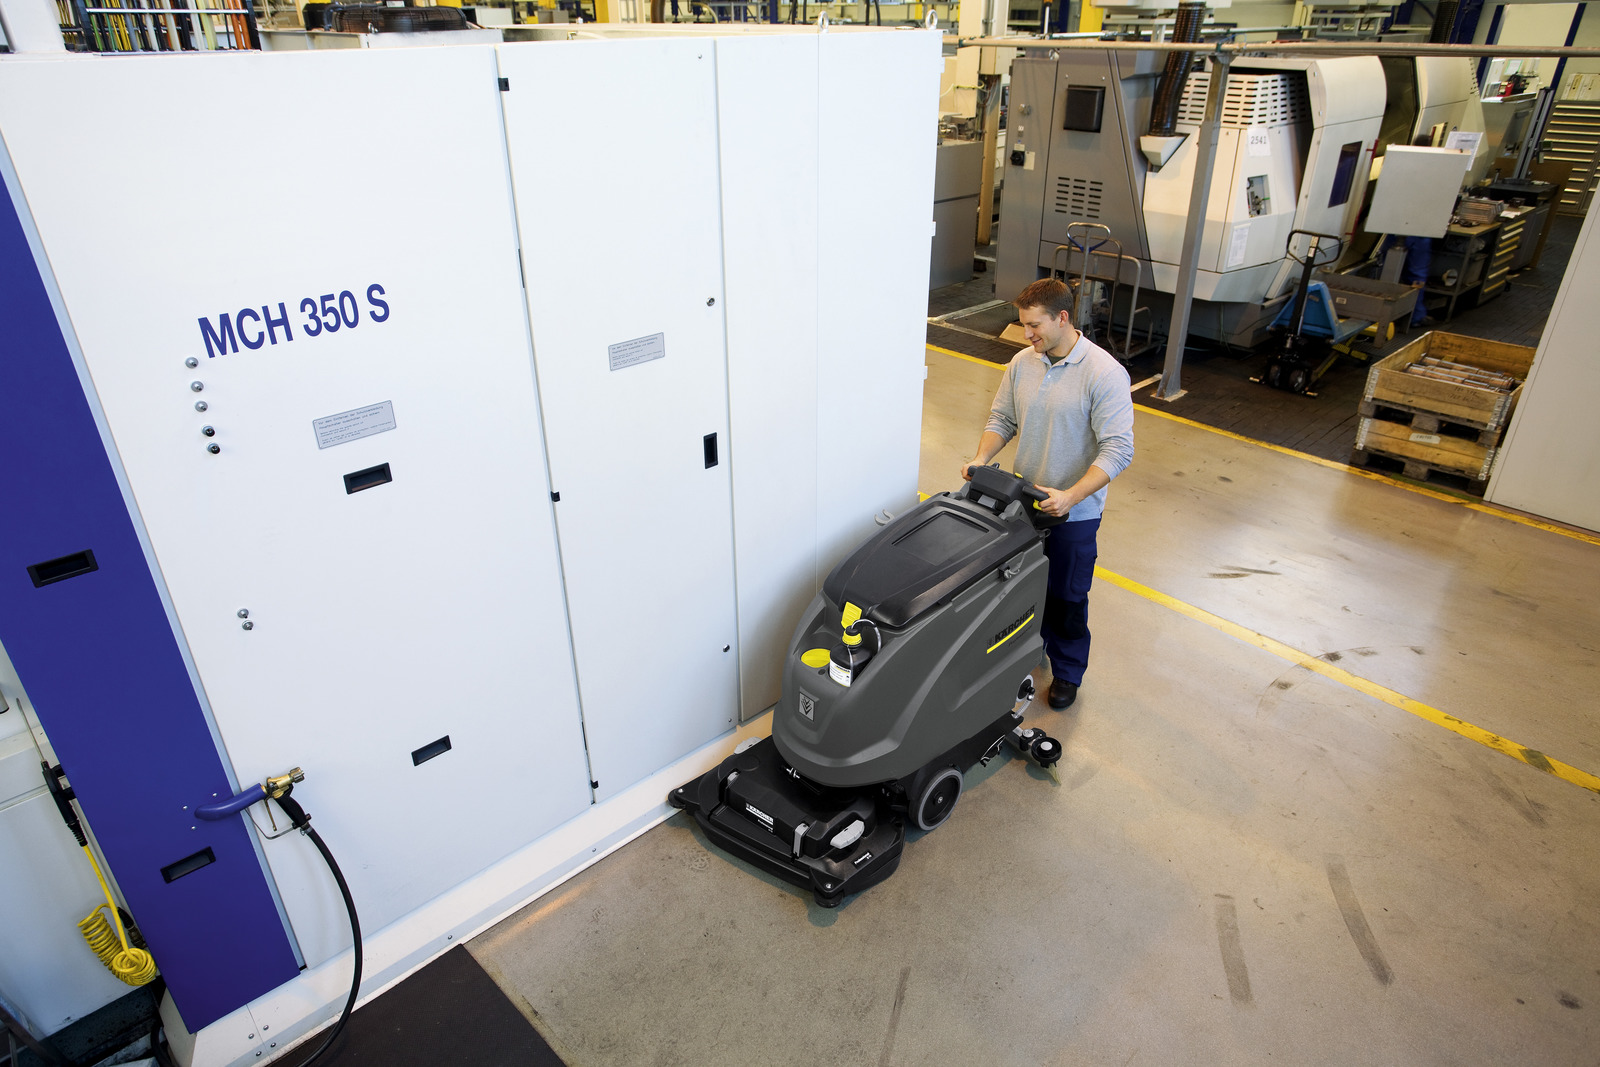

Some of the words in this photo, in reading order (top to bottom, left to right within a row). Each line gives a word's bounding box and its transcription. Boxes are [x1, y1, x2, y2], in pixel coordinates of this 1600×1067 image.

[1250, 135, 1267, 145] 2541
[198, 302, 293, 358] MCH
[300, 290, 359, 337] 350
[366, 283, 390, 323] S
